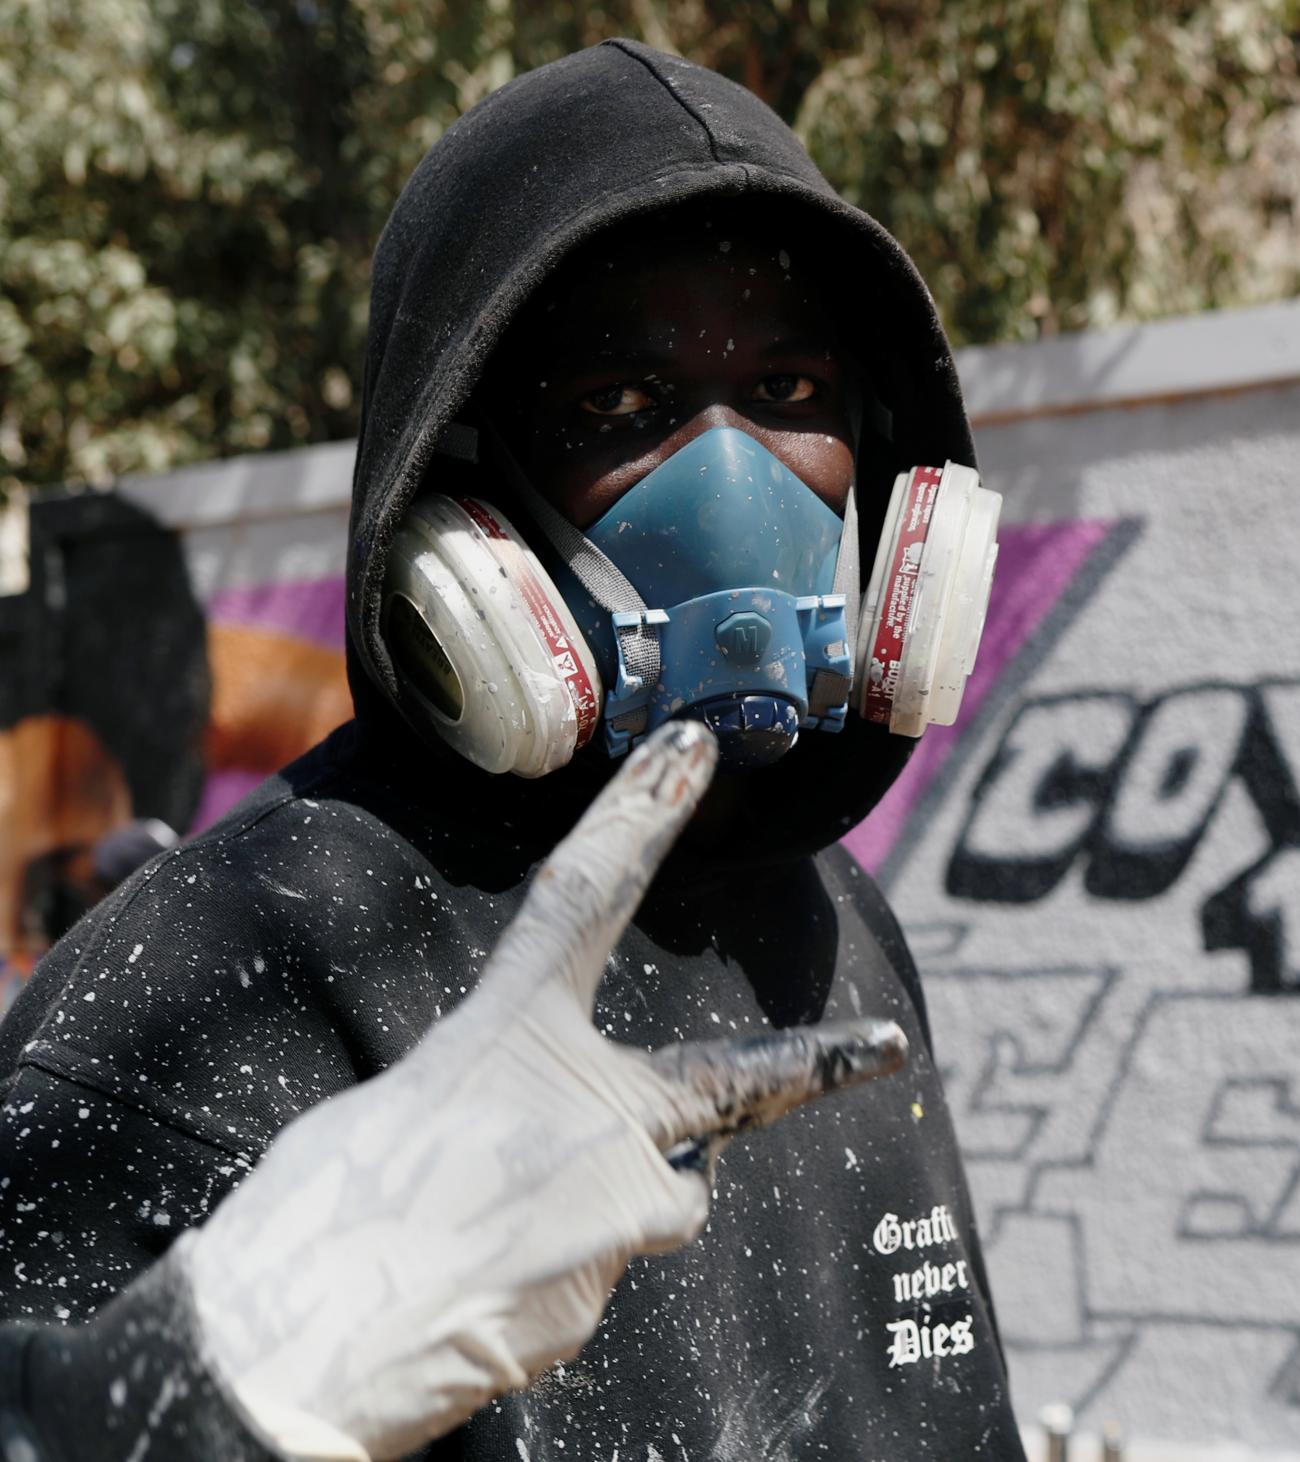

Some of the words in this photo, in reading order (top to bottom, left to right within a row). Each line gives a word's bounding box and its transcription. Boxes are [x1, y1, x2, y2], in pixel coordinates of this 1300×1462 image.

[897, 575, 911, 611] supplied
[892, 611, 906, 623] by
[892, 625, 903, 639] the
[893, 1260, 969, 1303] never
[886, 1314, 975, 1369] Dies
